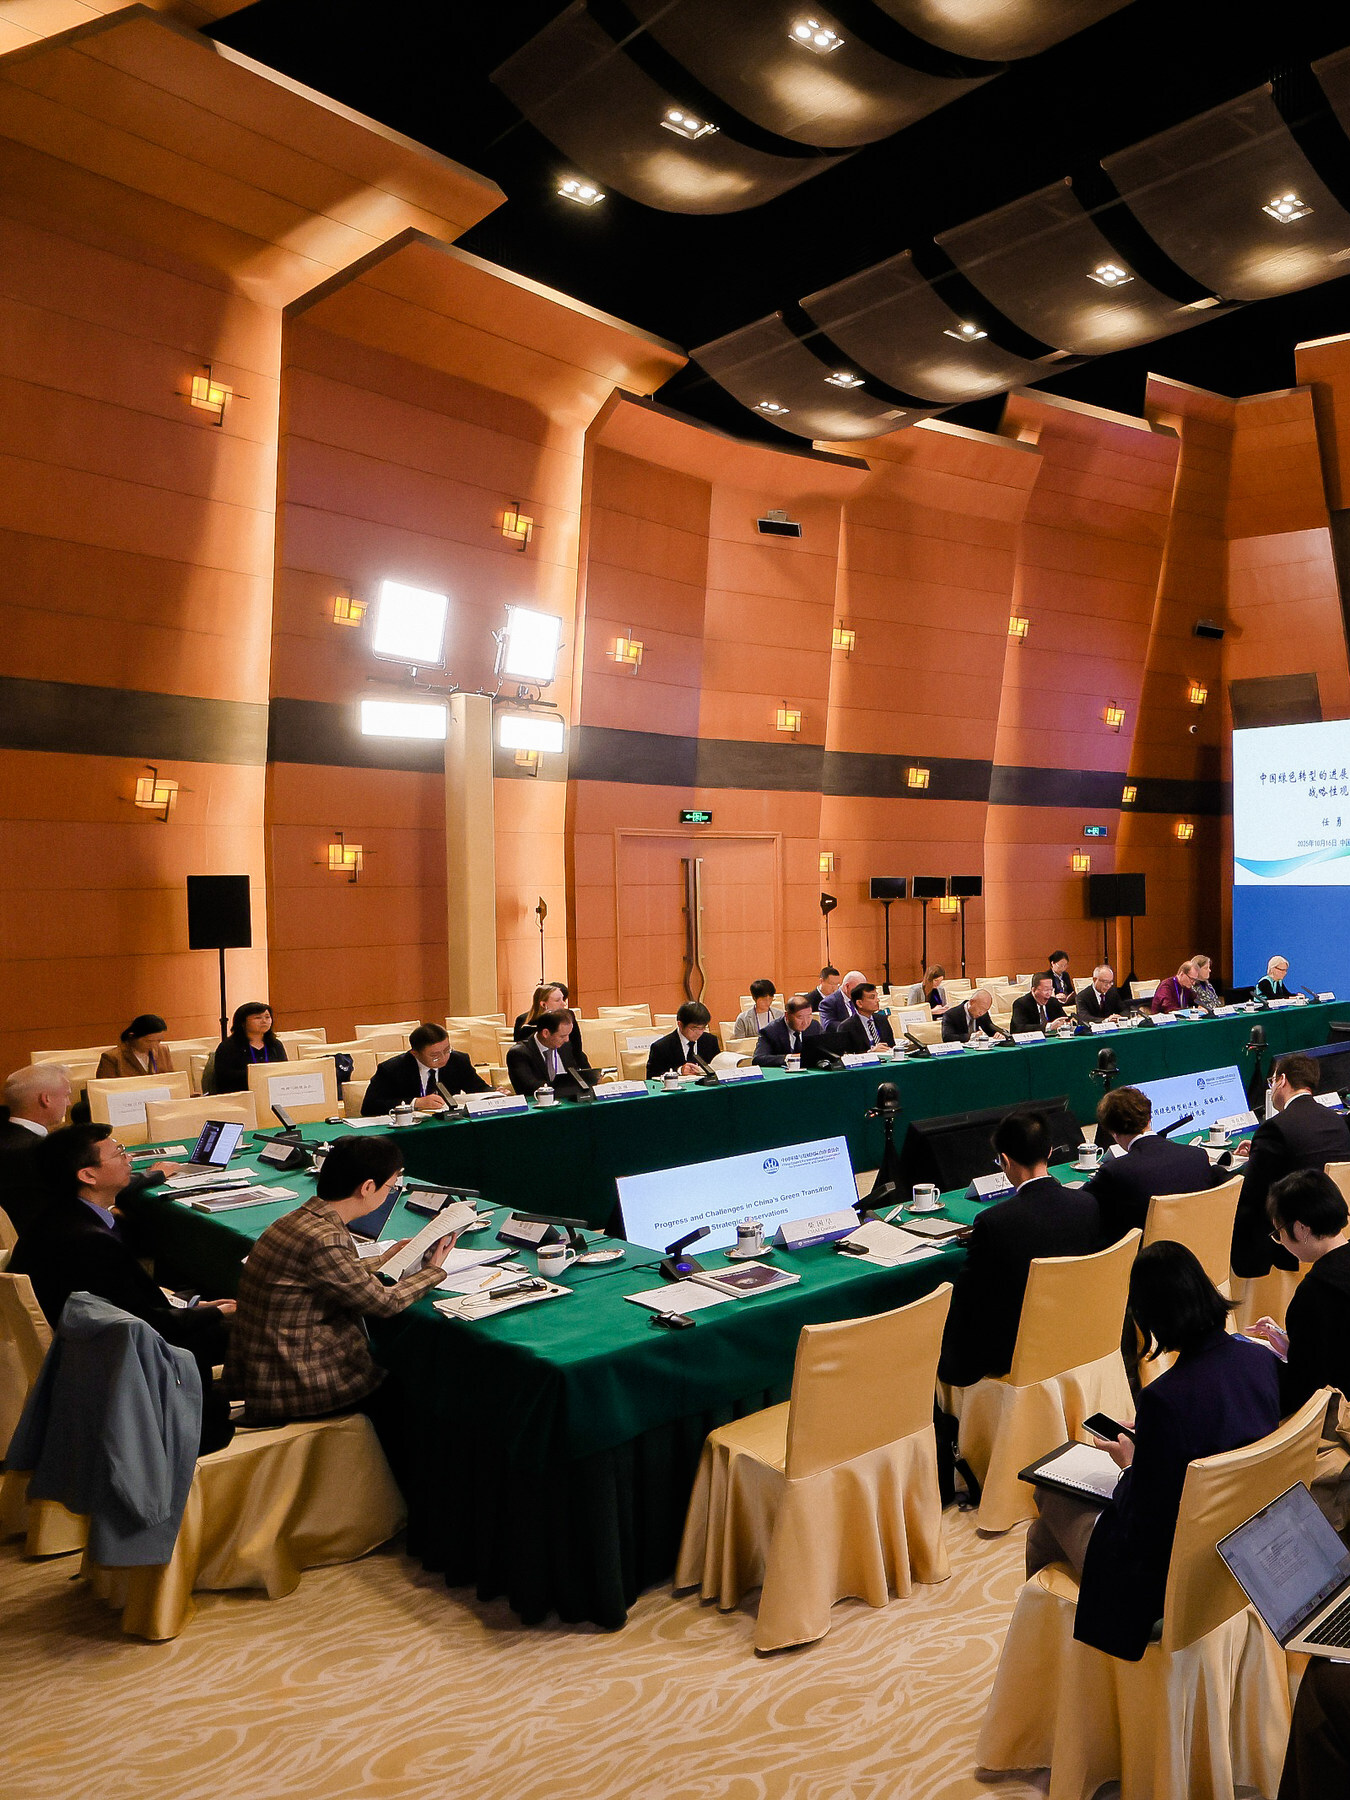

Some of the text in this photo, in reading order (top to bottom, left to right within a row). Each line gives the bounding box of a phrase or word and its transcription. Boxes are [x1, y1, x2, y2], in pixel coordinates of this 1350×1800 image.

[654, 1217, 688, 1230] Progress
[690, 1213, 704, 1222] and
[705, 1204, 744, 1218] Challenges
[780, 1192, 800, 1201] Green
[801, 1184, 833, 1197] Transition
[711, 1219, 743, 1231] Strategic
